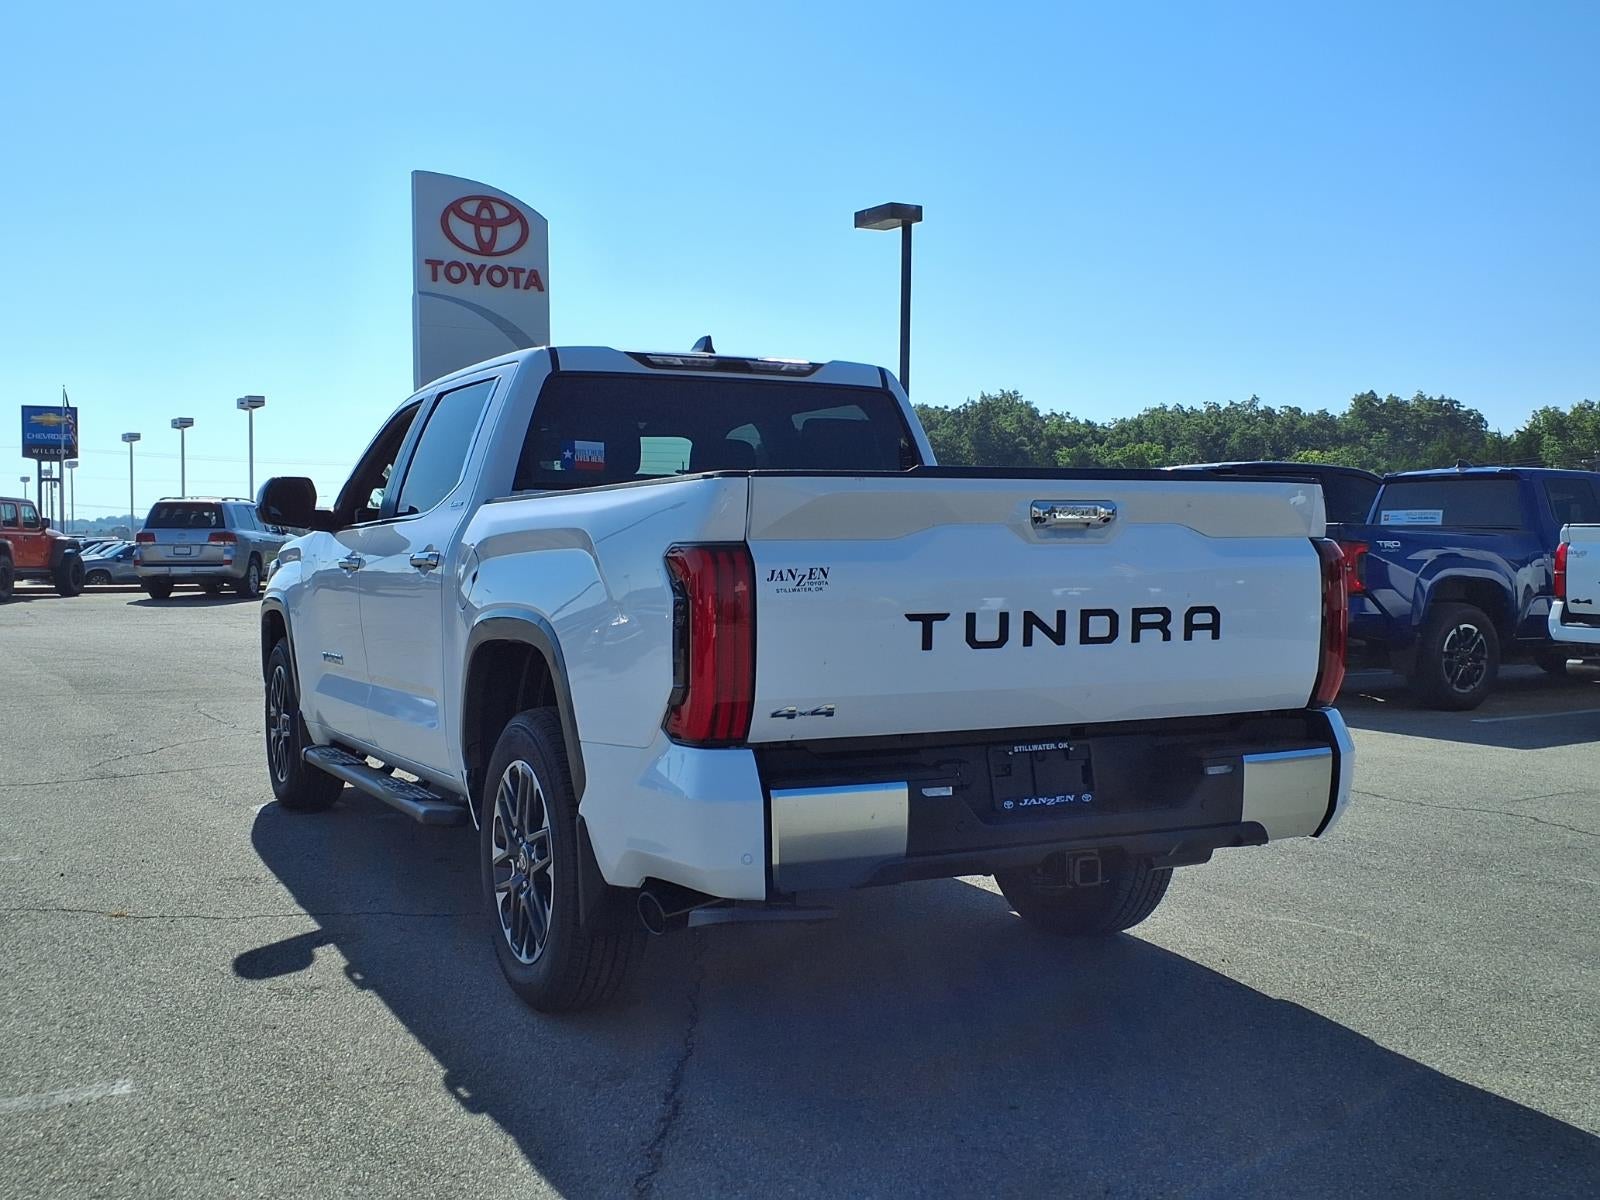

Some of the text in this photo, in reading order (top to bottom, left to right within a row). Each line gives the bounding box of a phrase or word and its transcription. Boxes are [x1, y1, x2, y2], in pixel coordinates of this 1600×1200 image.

[424, 258, 545, 293] TOYOTA
[26, 432, 73, 441] CHEVROLET
[31, 447, 70, 455] WILSON
[766, 566, 831, 587] JANZEN
[904, 605, 1221, 651] TUNDRA
[1057, 742, 1069, 750] OK
[1019, 793, 1075, 807] JANZEN
